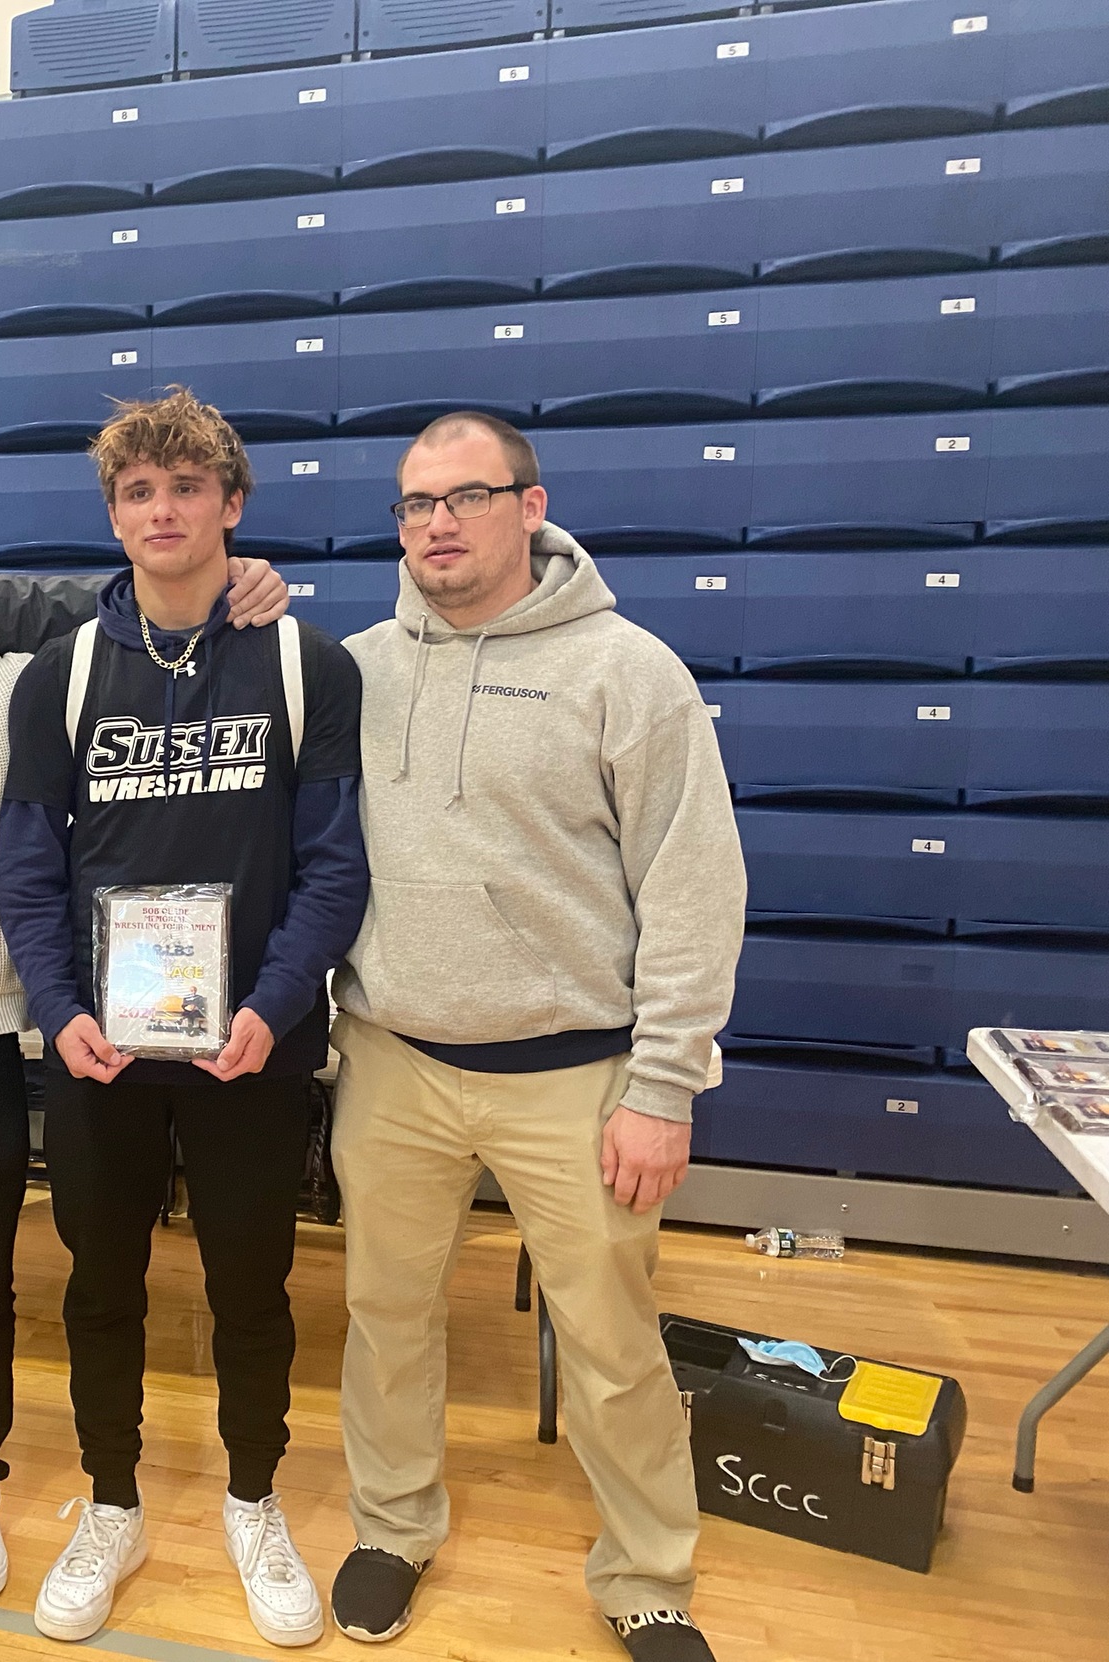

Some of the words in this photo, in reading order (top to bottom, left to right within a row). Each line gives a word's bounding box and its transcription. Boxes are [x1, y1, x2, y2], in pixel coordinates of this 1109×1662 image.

[481, 685, 548, 701] FERGUSON
[87, 714, 271, 777] SUSSEX
[89, 765, 266, 803] WRESTLING
